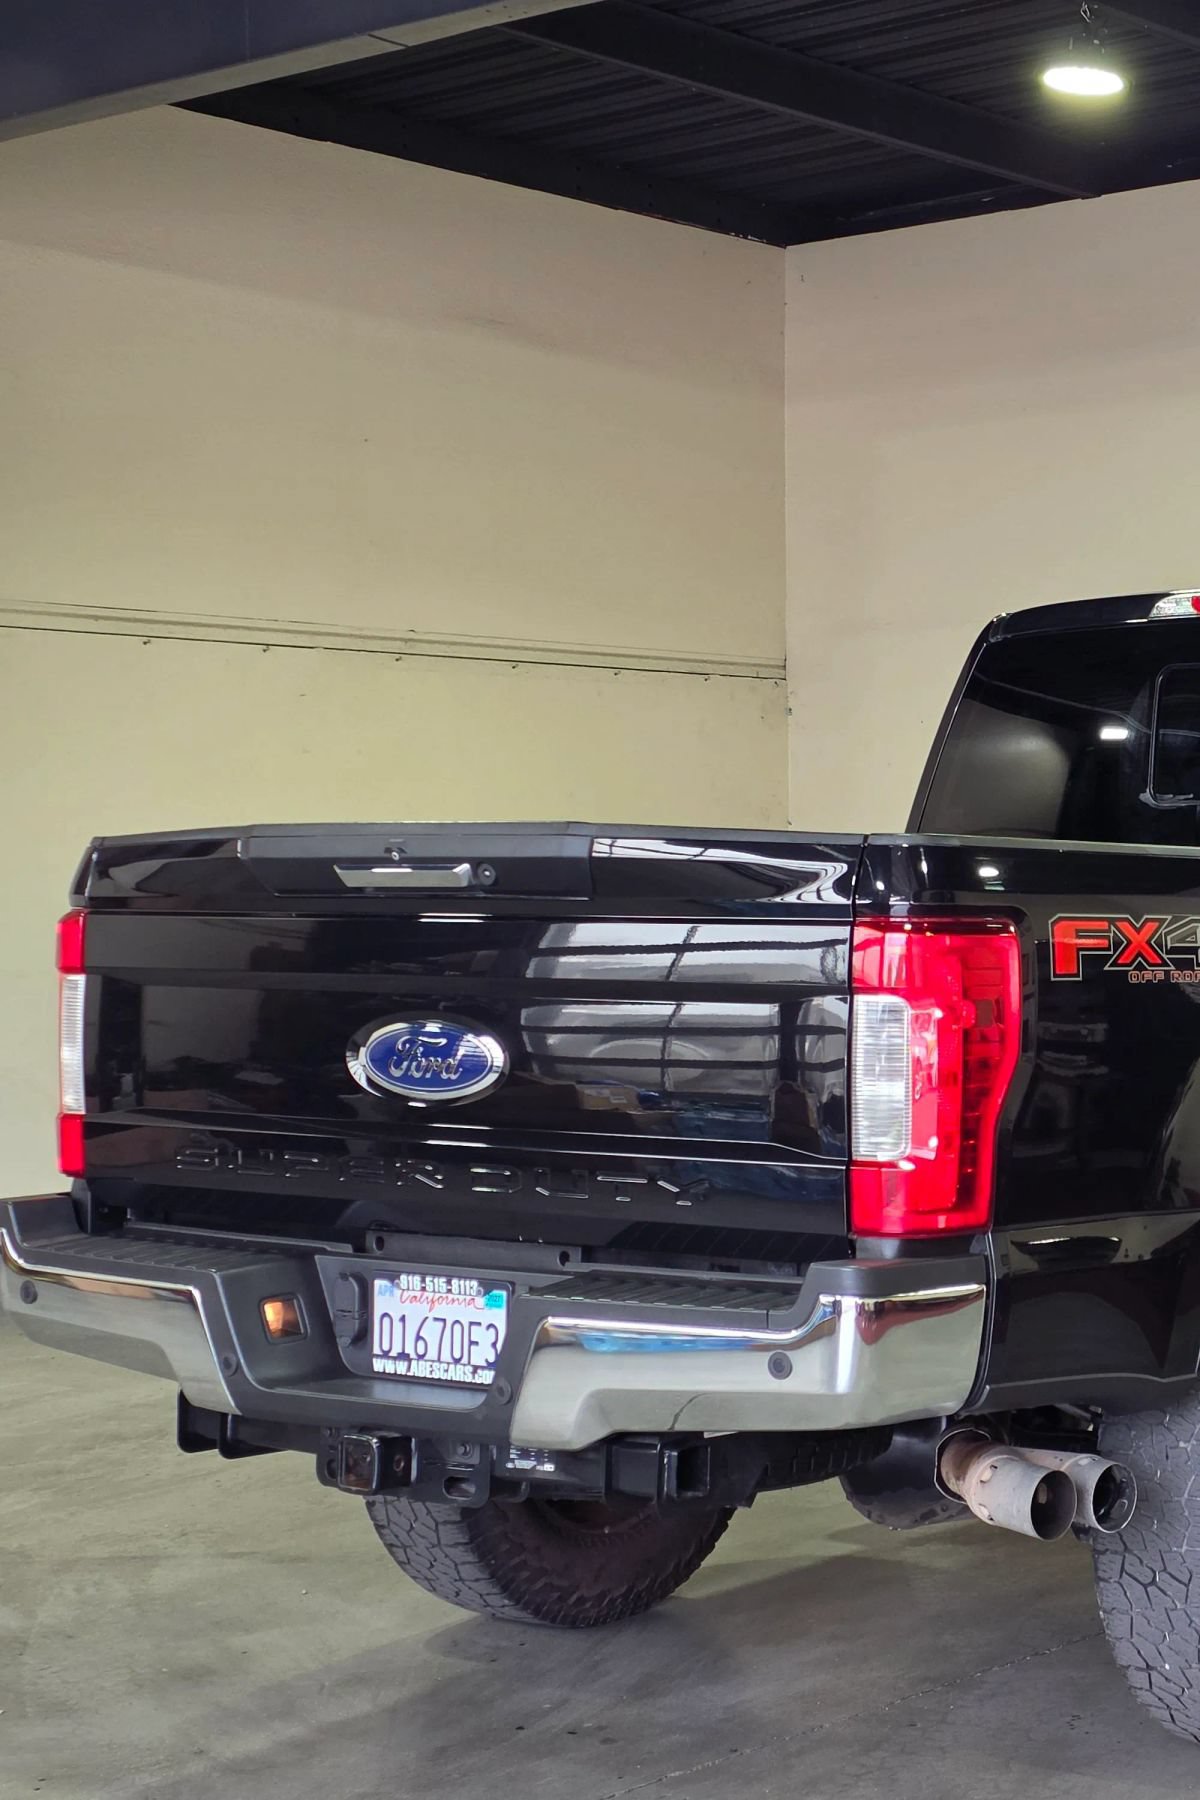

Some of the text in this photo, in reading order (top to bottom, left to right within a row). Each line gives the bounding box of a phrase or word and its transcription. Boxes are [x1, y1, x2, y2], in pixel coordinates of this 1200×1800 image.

[1128, 971, 1165, 984] OFF
[387, 1035, 464, 1080] Ford
[174, 1146, 712, 1206] SUPER DUTY
[378, 1312, 499, 1368] 01670F3
